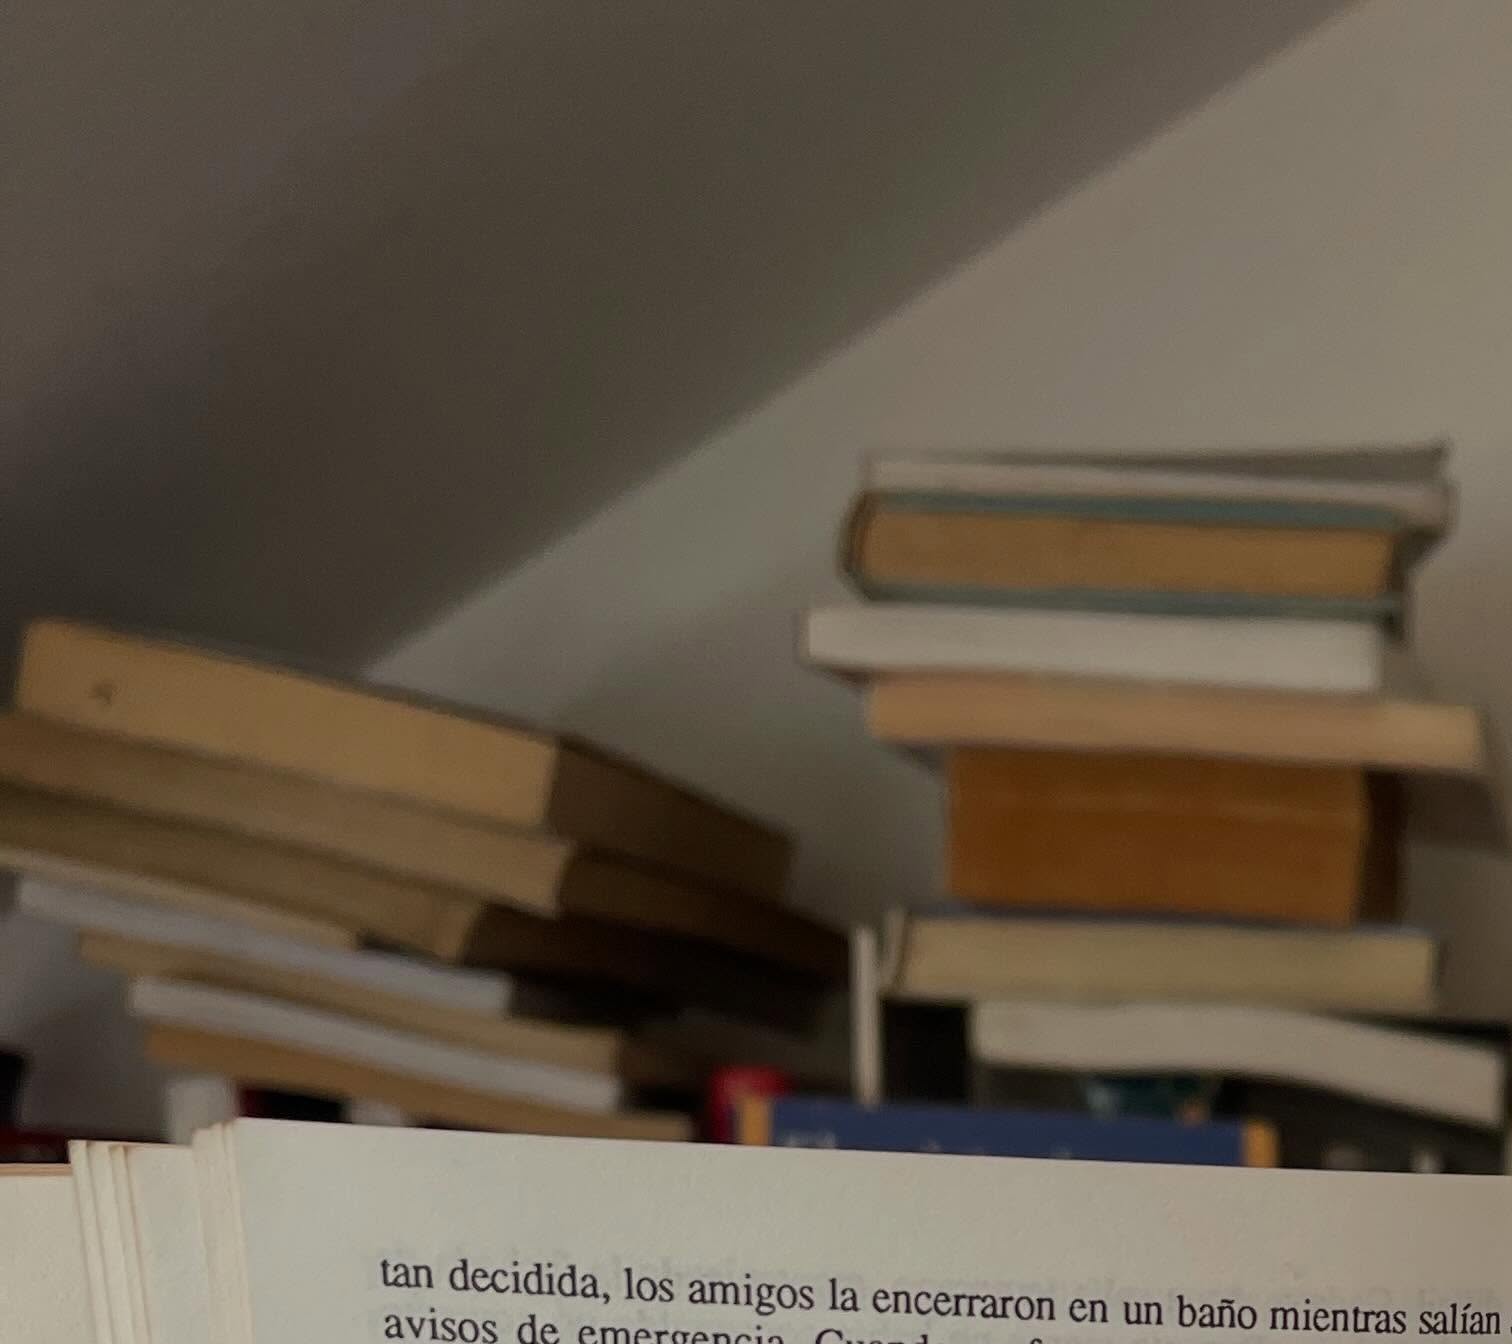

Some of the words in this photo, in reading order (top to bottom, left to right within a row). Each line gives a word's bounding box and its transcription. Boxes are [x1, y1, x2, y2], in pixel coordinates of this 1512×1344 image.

[381, 1259, 433, 1288] tan
[449, 1259, 610, 1304] decidida,
[624, 1267, 674, 1302] los
[689, 1273, 814, 1316] amigos
[829, 1278, 860, 1312] la
[872, 1289, 1055, 1320] encerraron
[1069, 1299, 1108, 1323] en
[1123, 1302, 1163, 1325] un
[1176, 1295, 1257, 1329] baño
[1270, 1298, 1406, 1334] mientras
[1419, 1303, 1500, 1335] salían
